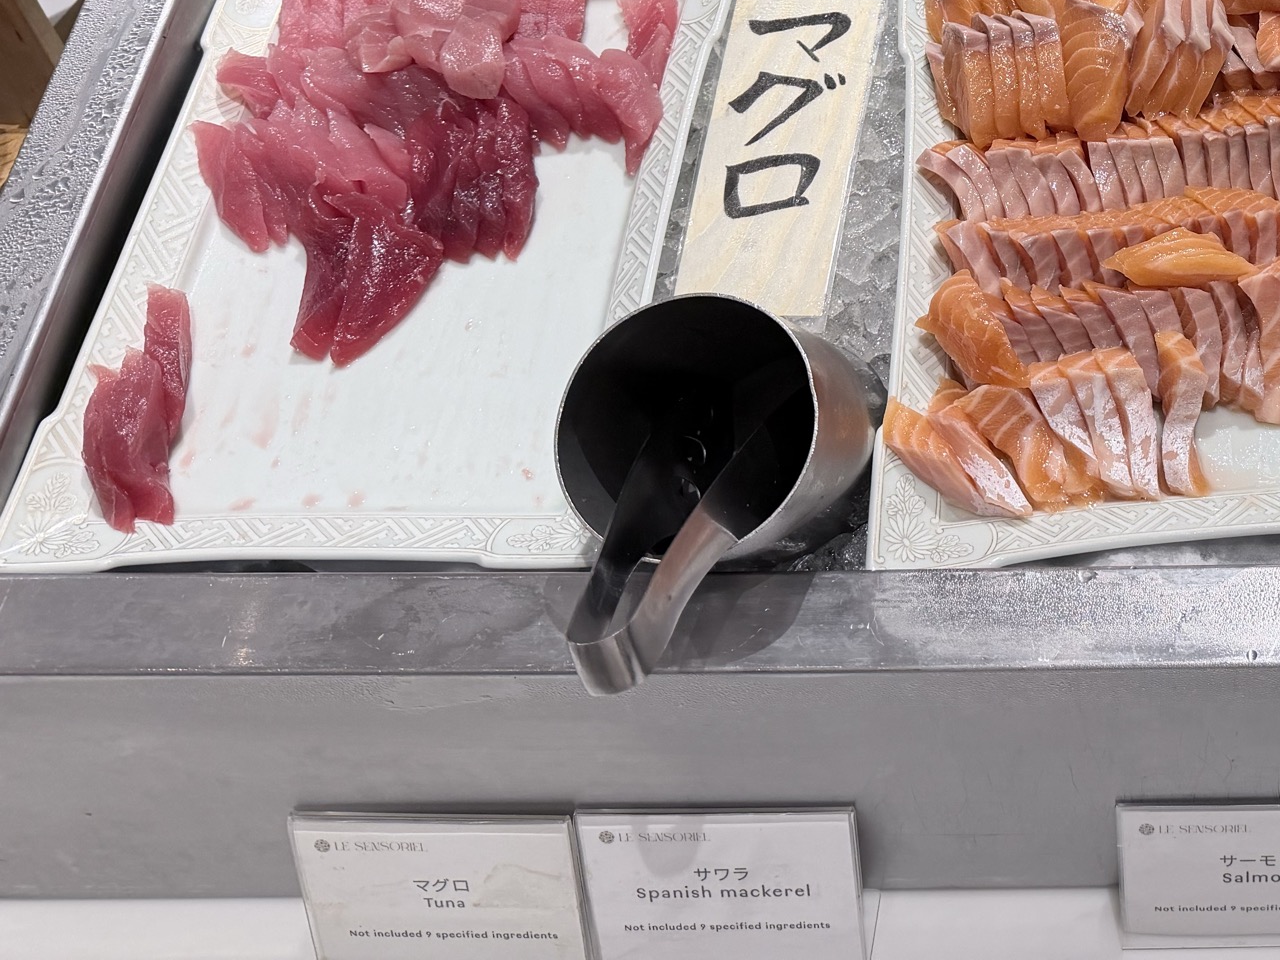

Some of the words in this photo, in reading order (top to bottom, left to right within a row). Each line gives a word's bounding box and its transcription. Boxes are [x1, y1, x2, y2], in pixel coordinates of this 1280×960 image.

[724, 12, 852, 219] マグロ
[1159, 825, 1174, 834] LE
[618, 833, 631, 842] LE
[334, 841, 350, 852] LE
[693, 867, 749, 881] サワラ
[412, 878, 470, 892] マグロ
[636, 885, 712, 902] Spanish
[720, 884, 811, 898] mackerel
[423, 897, 466, 909] Tuna
[1178, 904, 1227, 912] included
[624, 924, 645, 932] Not
[648, 923, 696, 931] included
[700, 923, 706, 931] 9
[709, 922, 762, 932] specified
[765, 921, 831, 932] ingredients
[350, 929, 369, 937] Not
[373, 929, 422, 938] included
[435, 930, 488, 940] specified
[491, 931, 559, 940] ingredients
